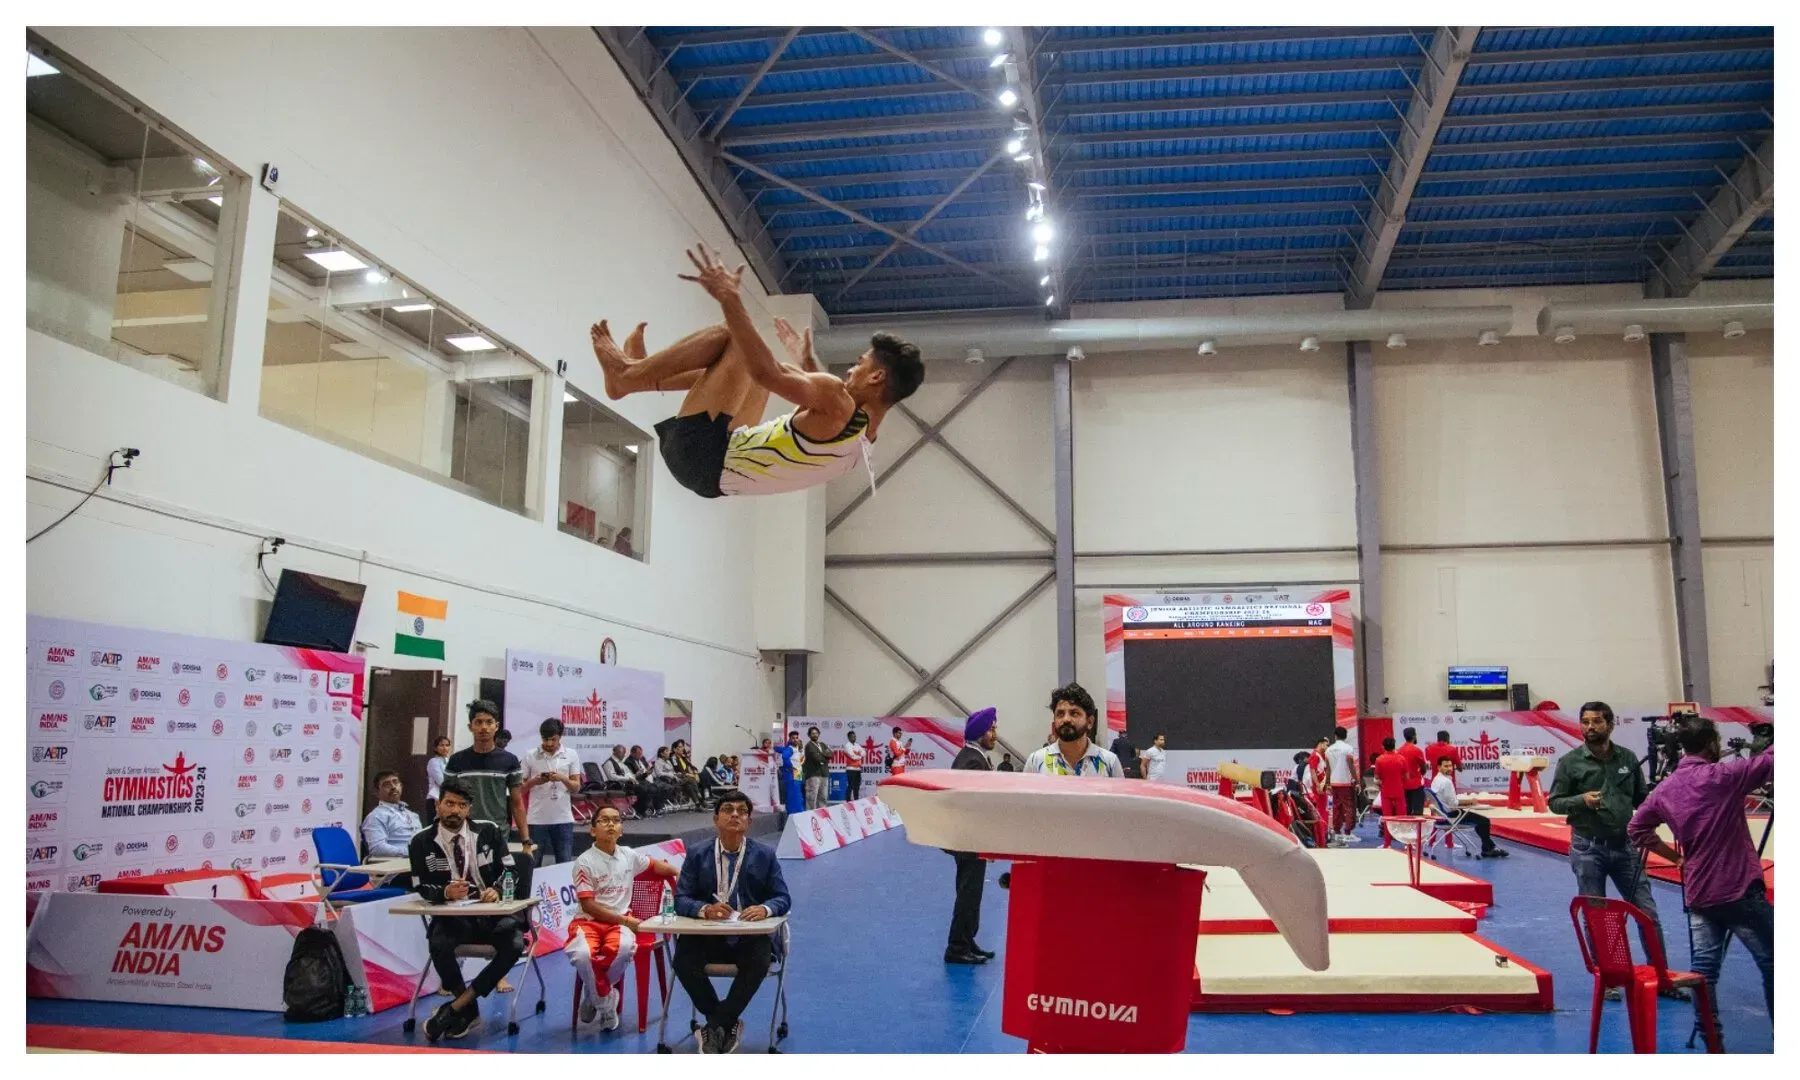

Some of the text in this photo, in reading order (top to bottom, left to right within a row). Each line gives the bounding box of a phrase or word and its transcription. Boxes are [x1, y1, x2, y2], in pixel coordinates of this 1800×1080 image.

[47, 647, 75, 657] AM/NS
[46, 655, 65, 663] INDIA
[137, 656, 160, 665] AM/NS
[140, 690, 162, 698] ODISHA
[39, 713, 68, 723] AM/NS
[561, 704, 602, 725] GYMNASTICS
[39, 721, 58, 729] INDIA
[131, 717, 155, 725] AM/NS
[103, 775, 195, 802] GYMNASTICS
[194, 766, 207, 813] 2023-24
[101, 802, 192, 819] NATIONAL CHAMPIONSHIPS
[29, 813, 58, 822] AM/NS
[28, 821, 48, 830] INDIA
[125, 842, 148, 850] ODISHA
[212, 884, 218, 898] 1
[122, 905, 177, 919] Powered by
[119, 922, 227, 953] AM/NS
[111, 950, 181, 977] INDIA
[1026, 993, 1139, 1023] GYMNOVA
